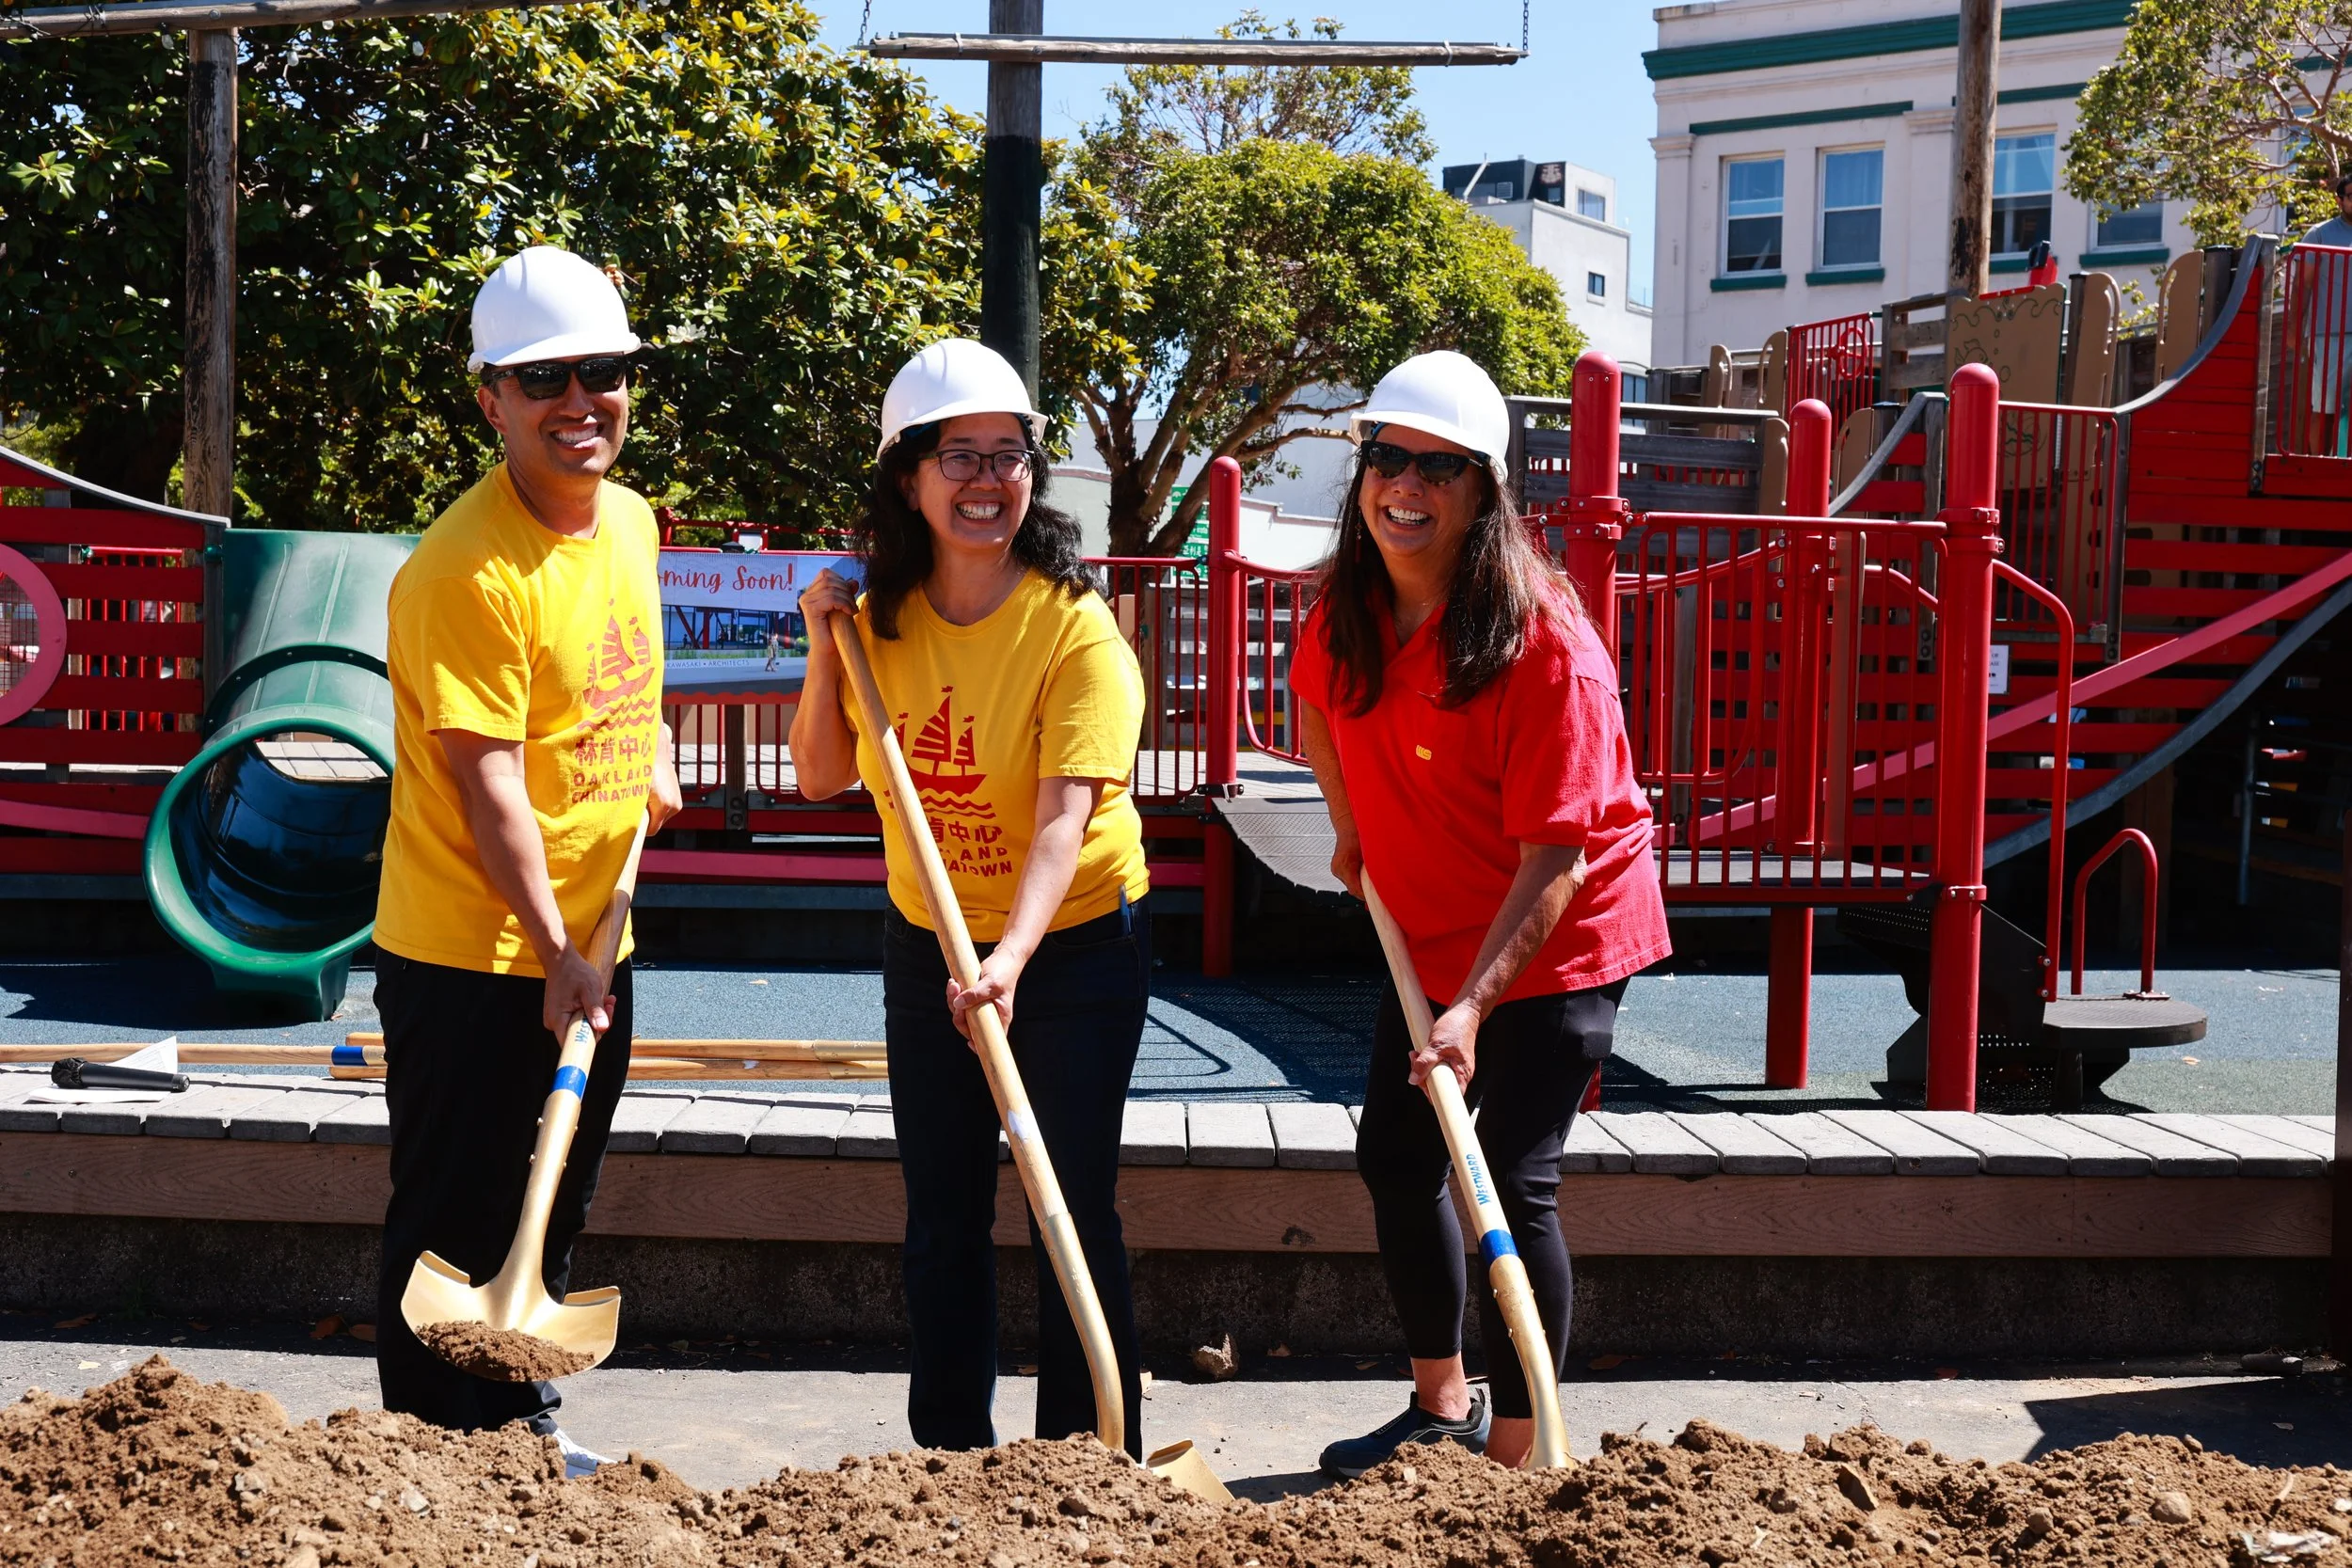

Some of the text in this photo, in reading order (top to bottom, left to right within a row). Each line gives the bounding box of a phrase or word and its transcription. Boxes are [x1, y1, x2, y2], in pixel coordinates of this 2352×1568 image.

[657, 562, 793, 594] ming Soon!
[575, 732, 651, 767] 林肯中心
[928, 816, 1003, 845] 肯中心
[942, 859, 1013, 878] ATOWN
